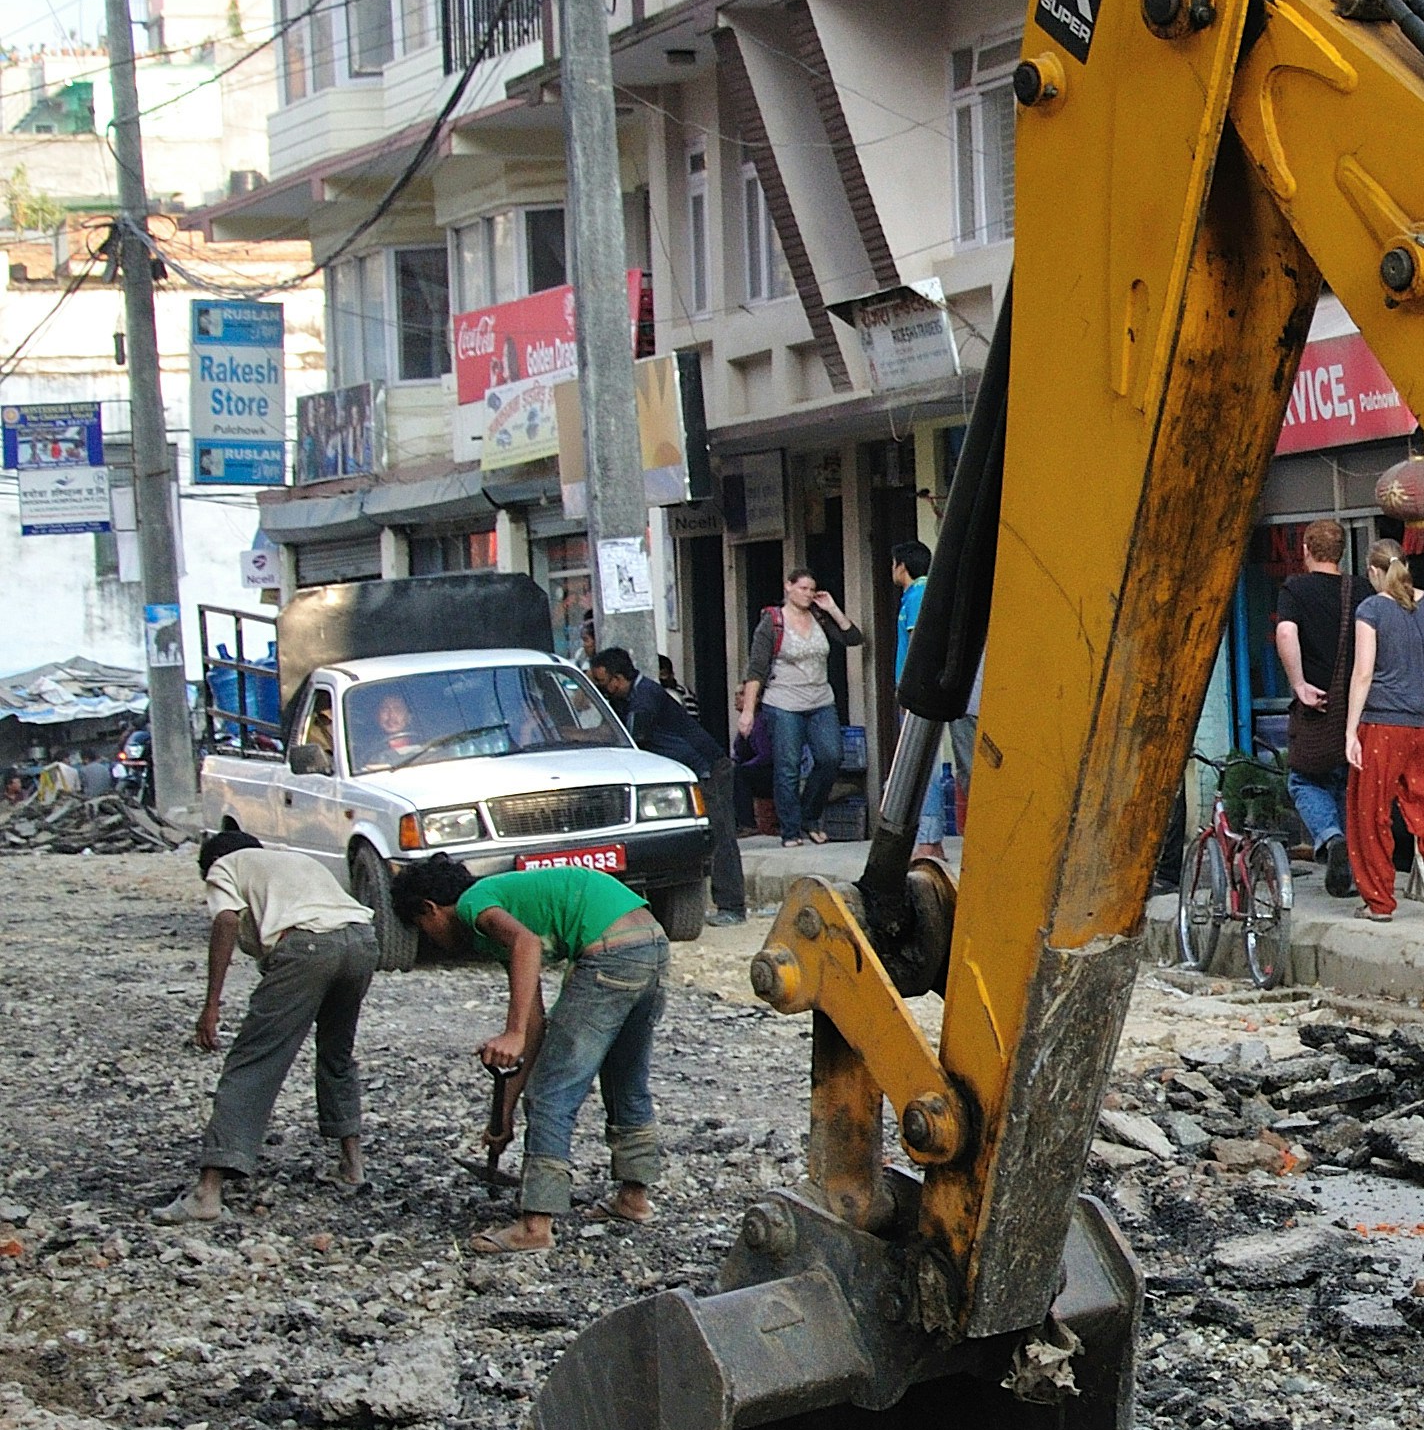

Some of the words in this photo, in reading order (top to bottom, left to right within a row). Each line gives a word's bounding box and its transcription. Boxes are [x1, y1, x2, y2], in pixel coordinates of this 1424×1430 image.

[223, 307, 280, 323] RUSLAN
[527, 339, 556, 376] Golden
[200, 355, 279, 385] Rakesh
[211, 388, 269, 417] Store
[1359, 387, 1401, 413] Pulchowk
[213, 424, 267, 437] Pulchowk
[224, 448, 281, 461] RUSLAN
[675, 516, 717, 531] Ncell
[246, 574, 275, 584] Ncell
